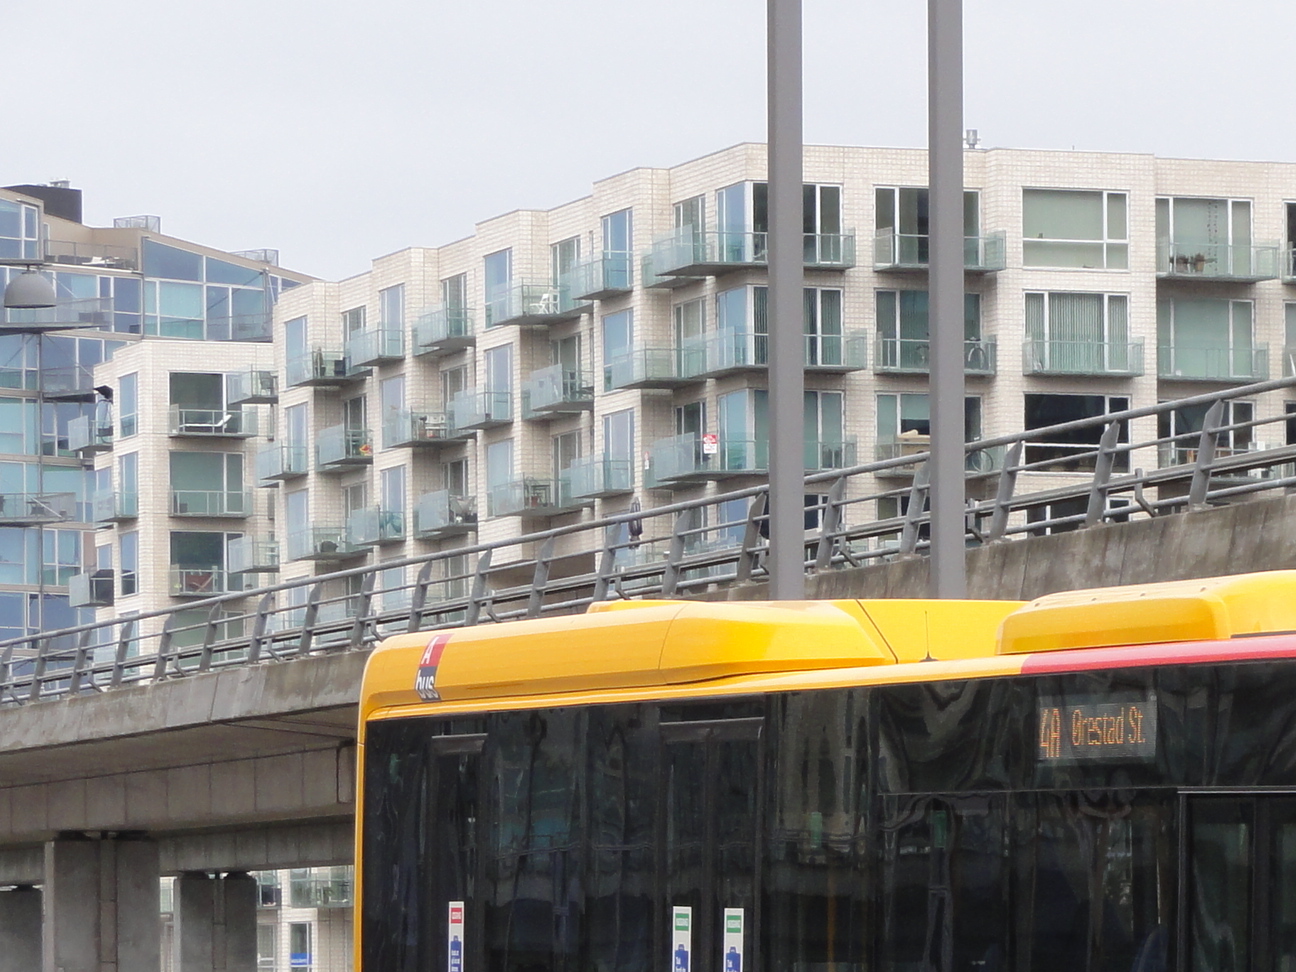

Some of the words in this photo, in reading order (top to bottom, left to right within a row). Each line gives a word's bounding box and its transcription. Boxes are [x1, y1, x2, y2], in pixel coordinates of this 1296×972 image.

[420, 635, 440, 665] A
[415, 669, 439, 699] bus
[1040, 708, 1061, 758] 4A
[1072, 706, 1124, 745] Ørestad
[1128, 706, 1145, 743] St.
